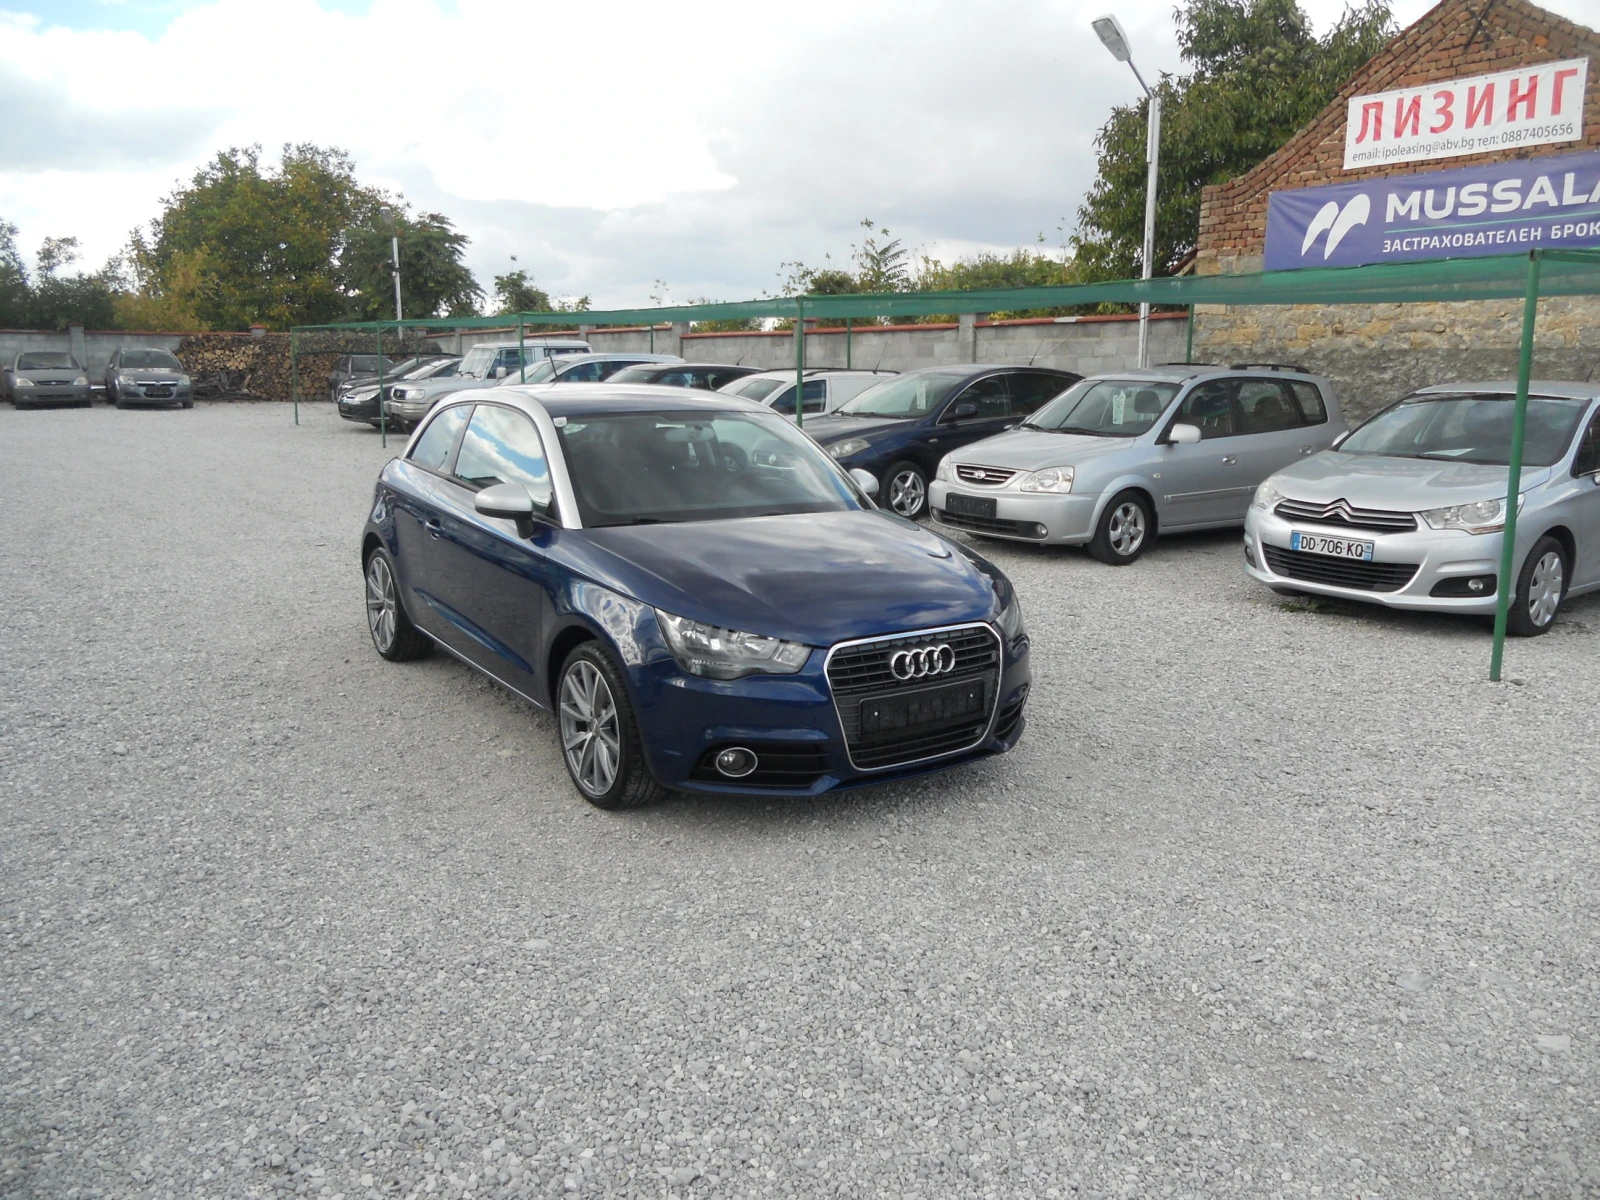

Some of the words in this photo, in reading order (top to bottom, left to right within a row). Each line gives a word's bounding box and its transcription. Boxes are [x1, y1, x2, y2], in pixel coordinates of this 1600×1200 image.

[1355, 68, 1578, 144] ЛИЗИНГ
[1352, 148, 1380, 161] email:
[1382, 136, 1475, 159] ipoleasing@abv.bg
[1477, 135, 1499, 147] тел:
[1501, 123, 1573, 143] 0887405656
[1382, 227, 1542, 253] ЗАСТРАХОВАТЕЛЕН
[1551, 221, 1600, 239] БРОК
